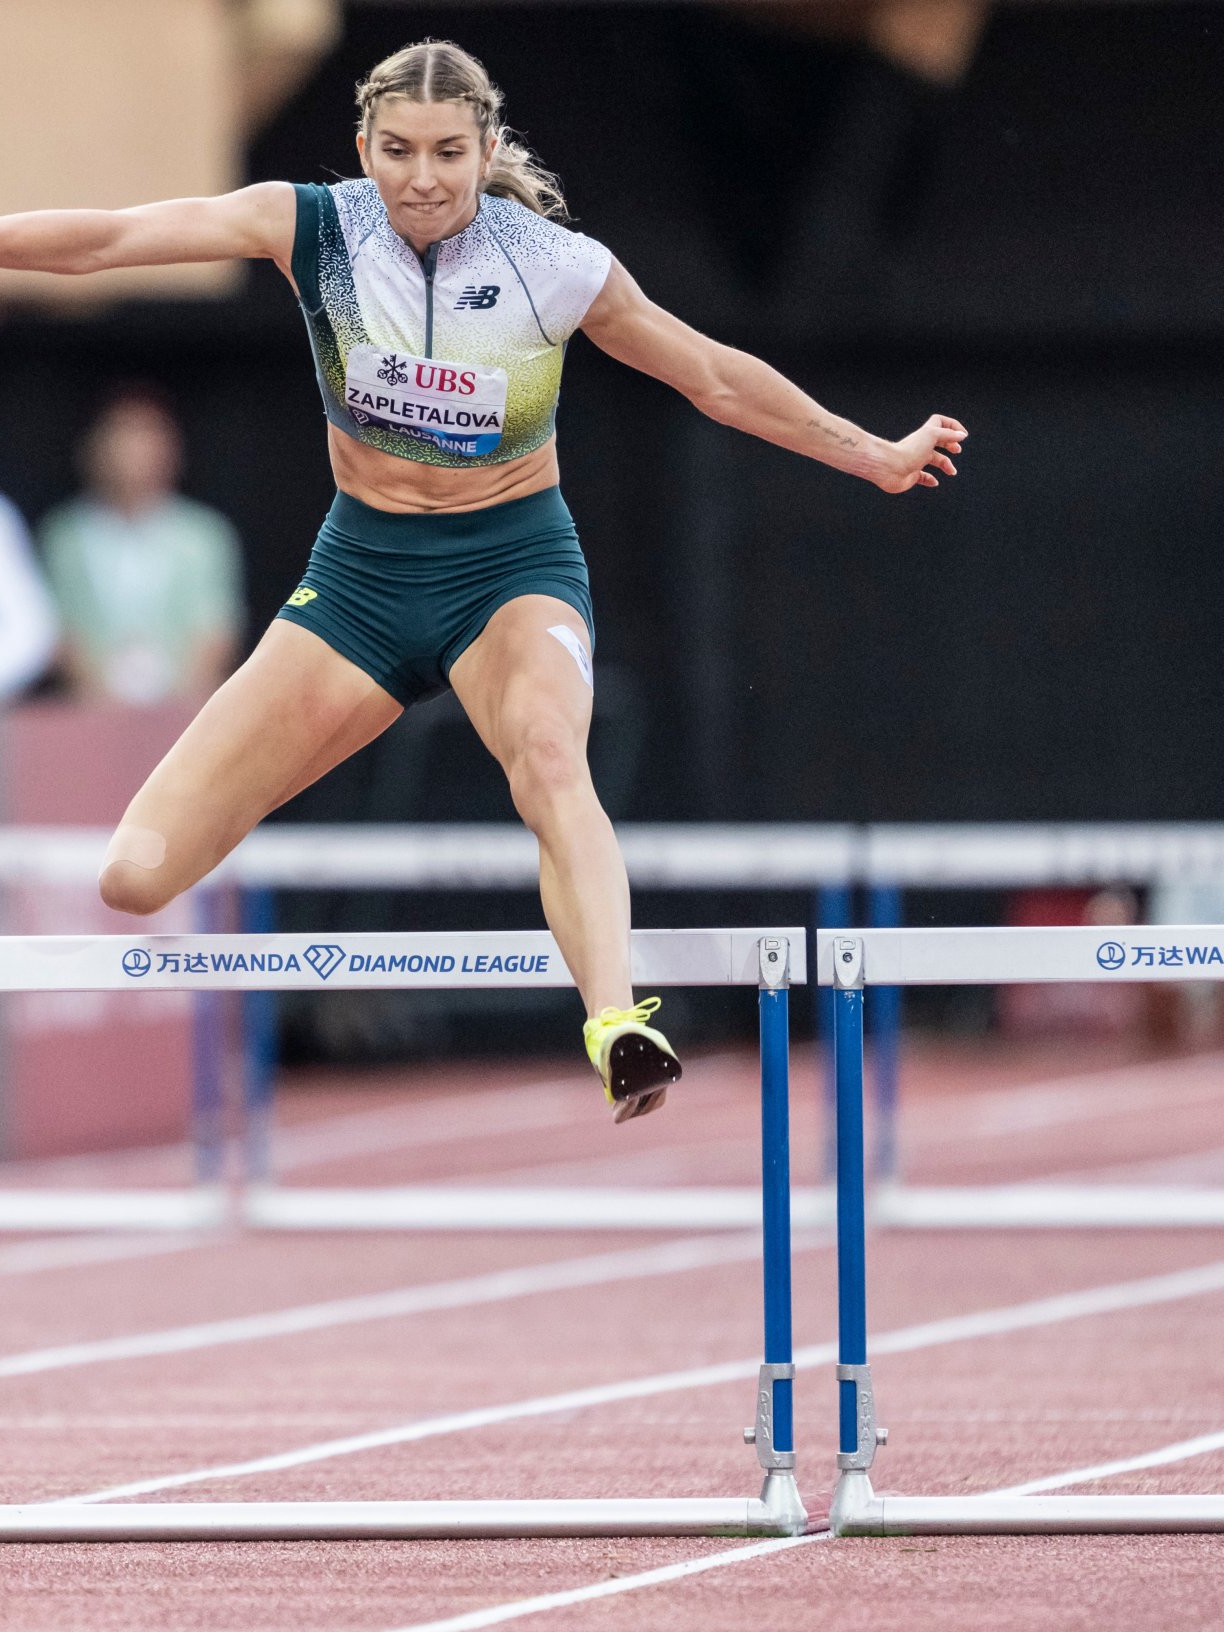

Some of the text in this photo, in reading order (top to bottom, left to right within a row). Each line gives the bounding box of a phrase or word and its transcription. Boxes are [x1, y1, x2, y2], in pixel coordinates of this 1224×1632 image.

[415, 363, 476, 396] UBS
[347, 386, 501, 428] ZAPLETALOVÁ
[388, 423, 477, 453] LAUSANNE
[348, 954, 455, 973] DIAMOND
[461, 955, 549, 973] LEAGUE
